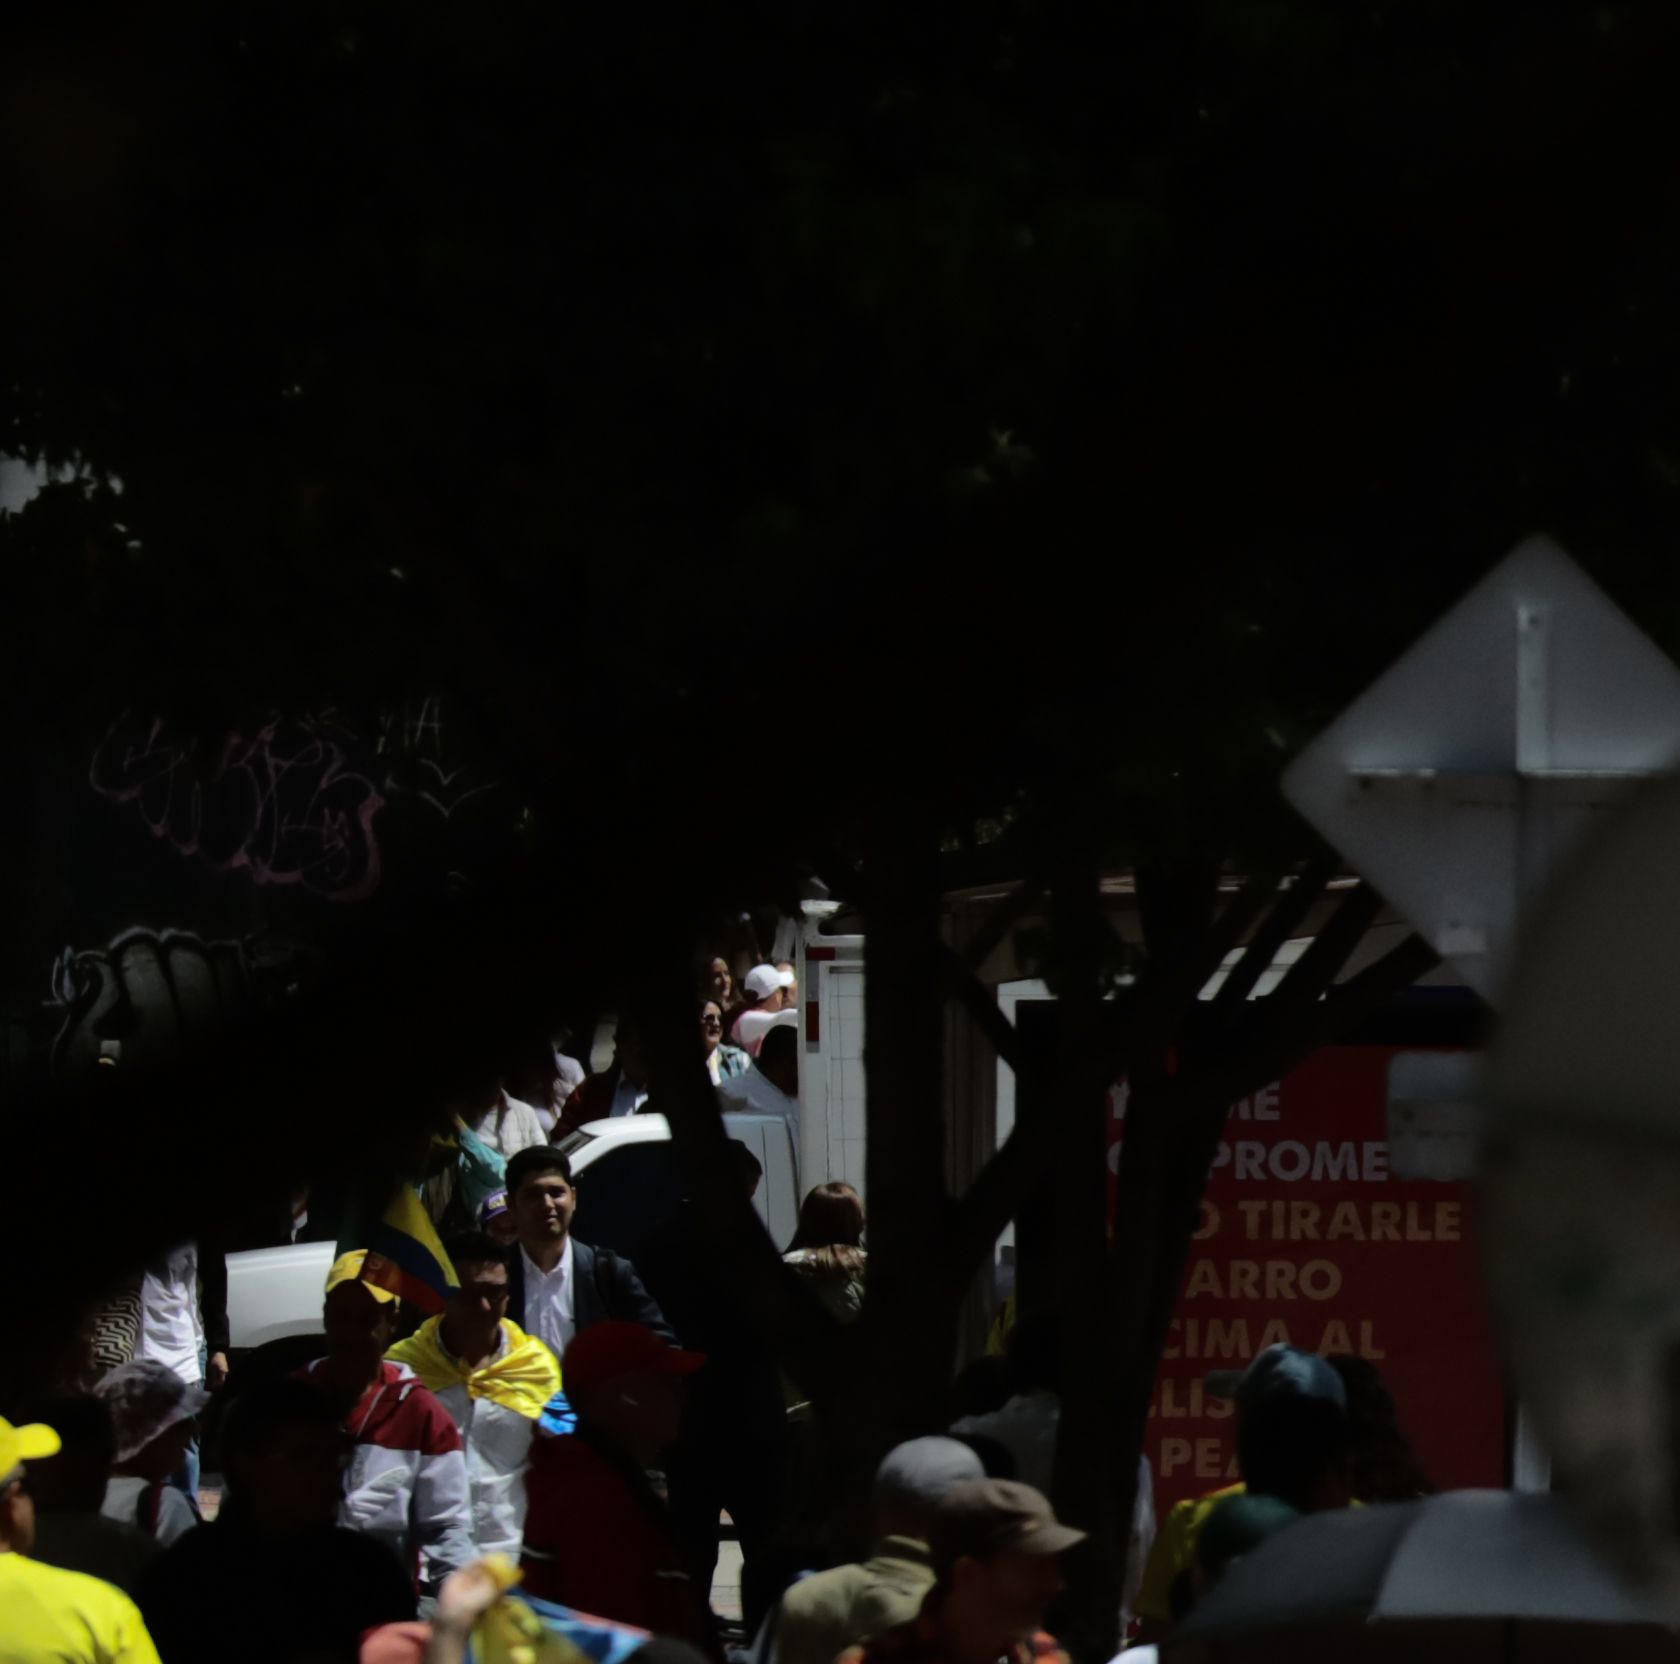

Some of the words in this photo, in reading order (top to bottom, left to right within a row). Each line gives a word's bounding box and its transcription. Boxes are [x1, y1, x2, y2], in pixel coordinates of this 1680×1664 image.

[1238, 1200, 1461, 1241] TIRARLE
[1185, 1259, 1343, 1301] ARRO
[1315, 1319, 1385, 1361] AL
